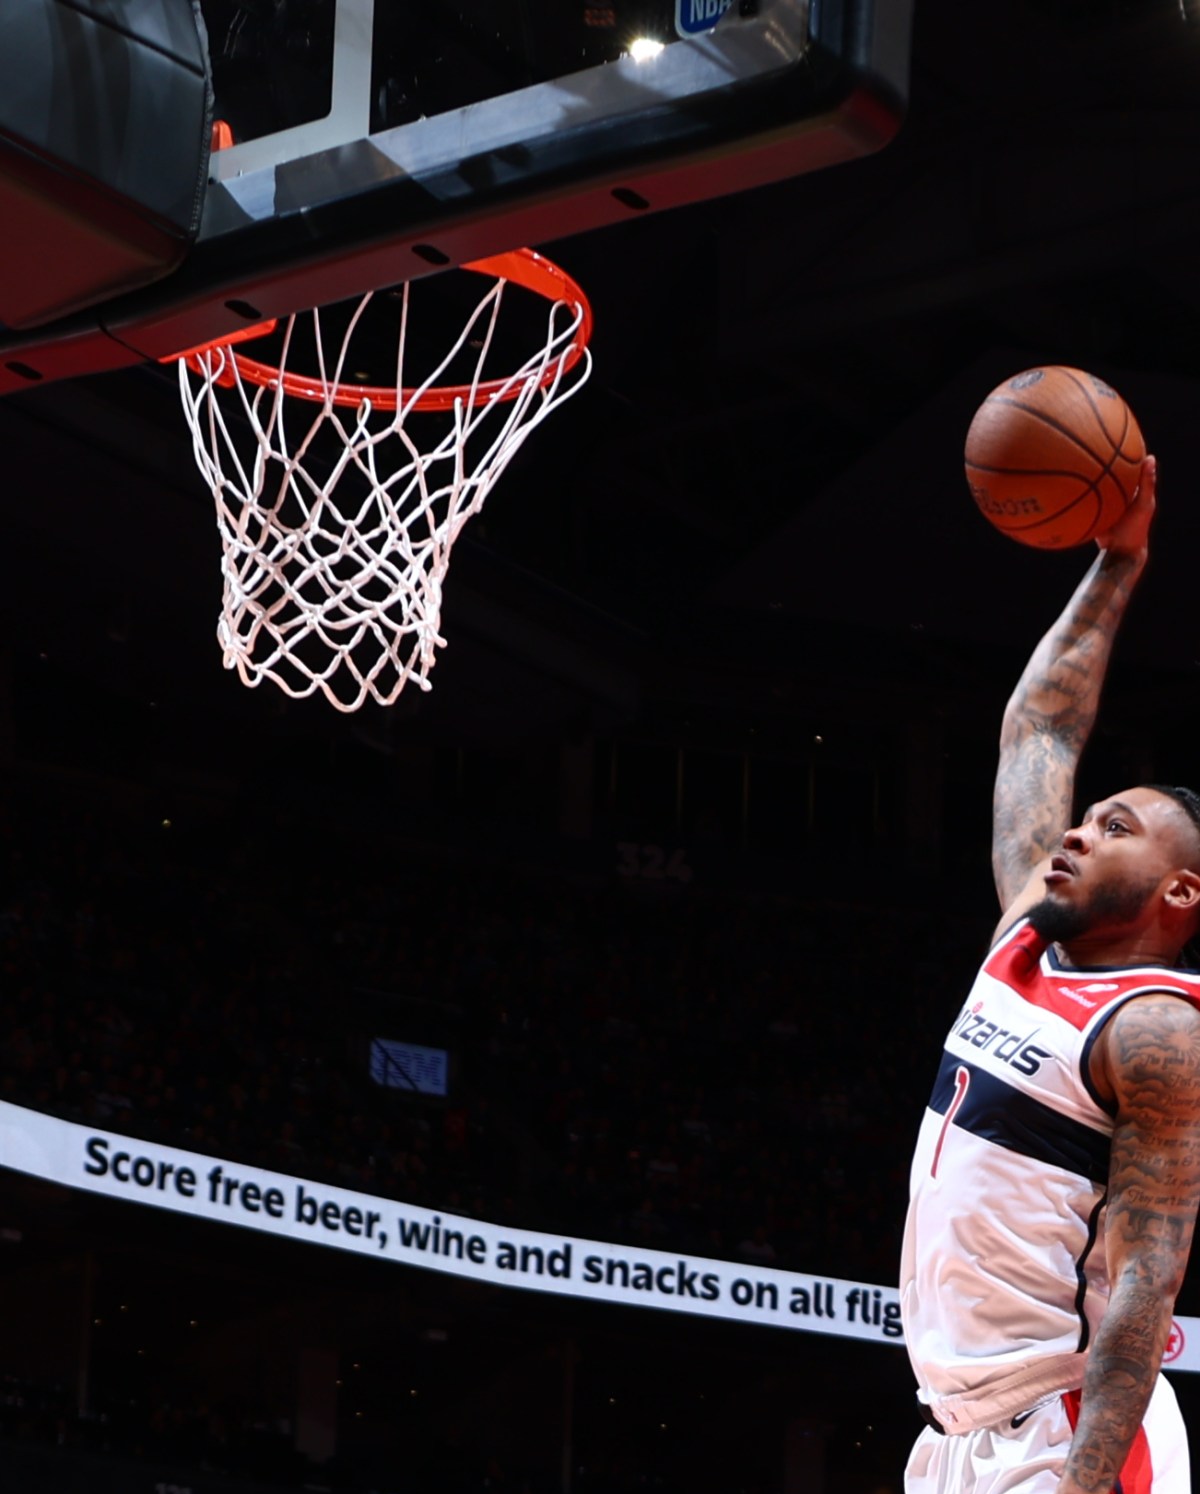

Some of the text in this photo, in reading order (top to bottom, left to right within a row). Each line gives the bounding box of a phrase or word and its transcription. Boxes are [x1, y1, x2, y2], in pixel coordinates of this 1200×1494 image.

[84, 1137, 903, 1337] Score free beer, wine and snacks on all flig
